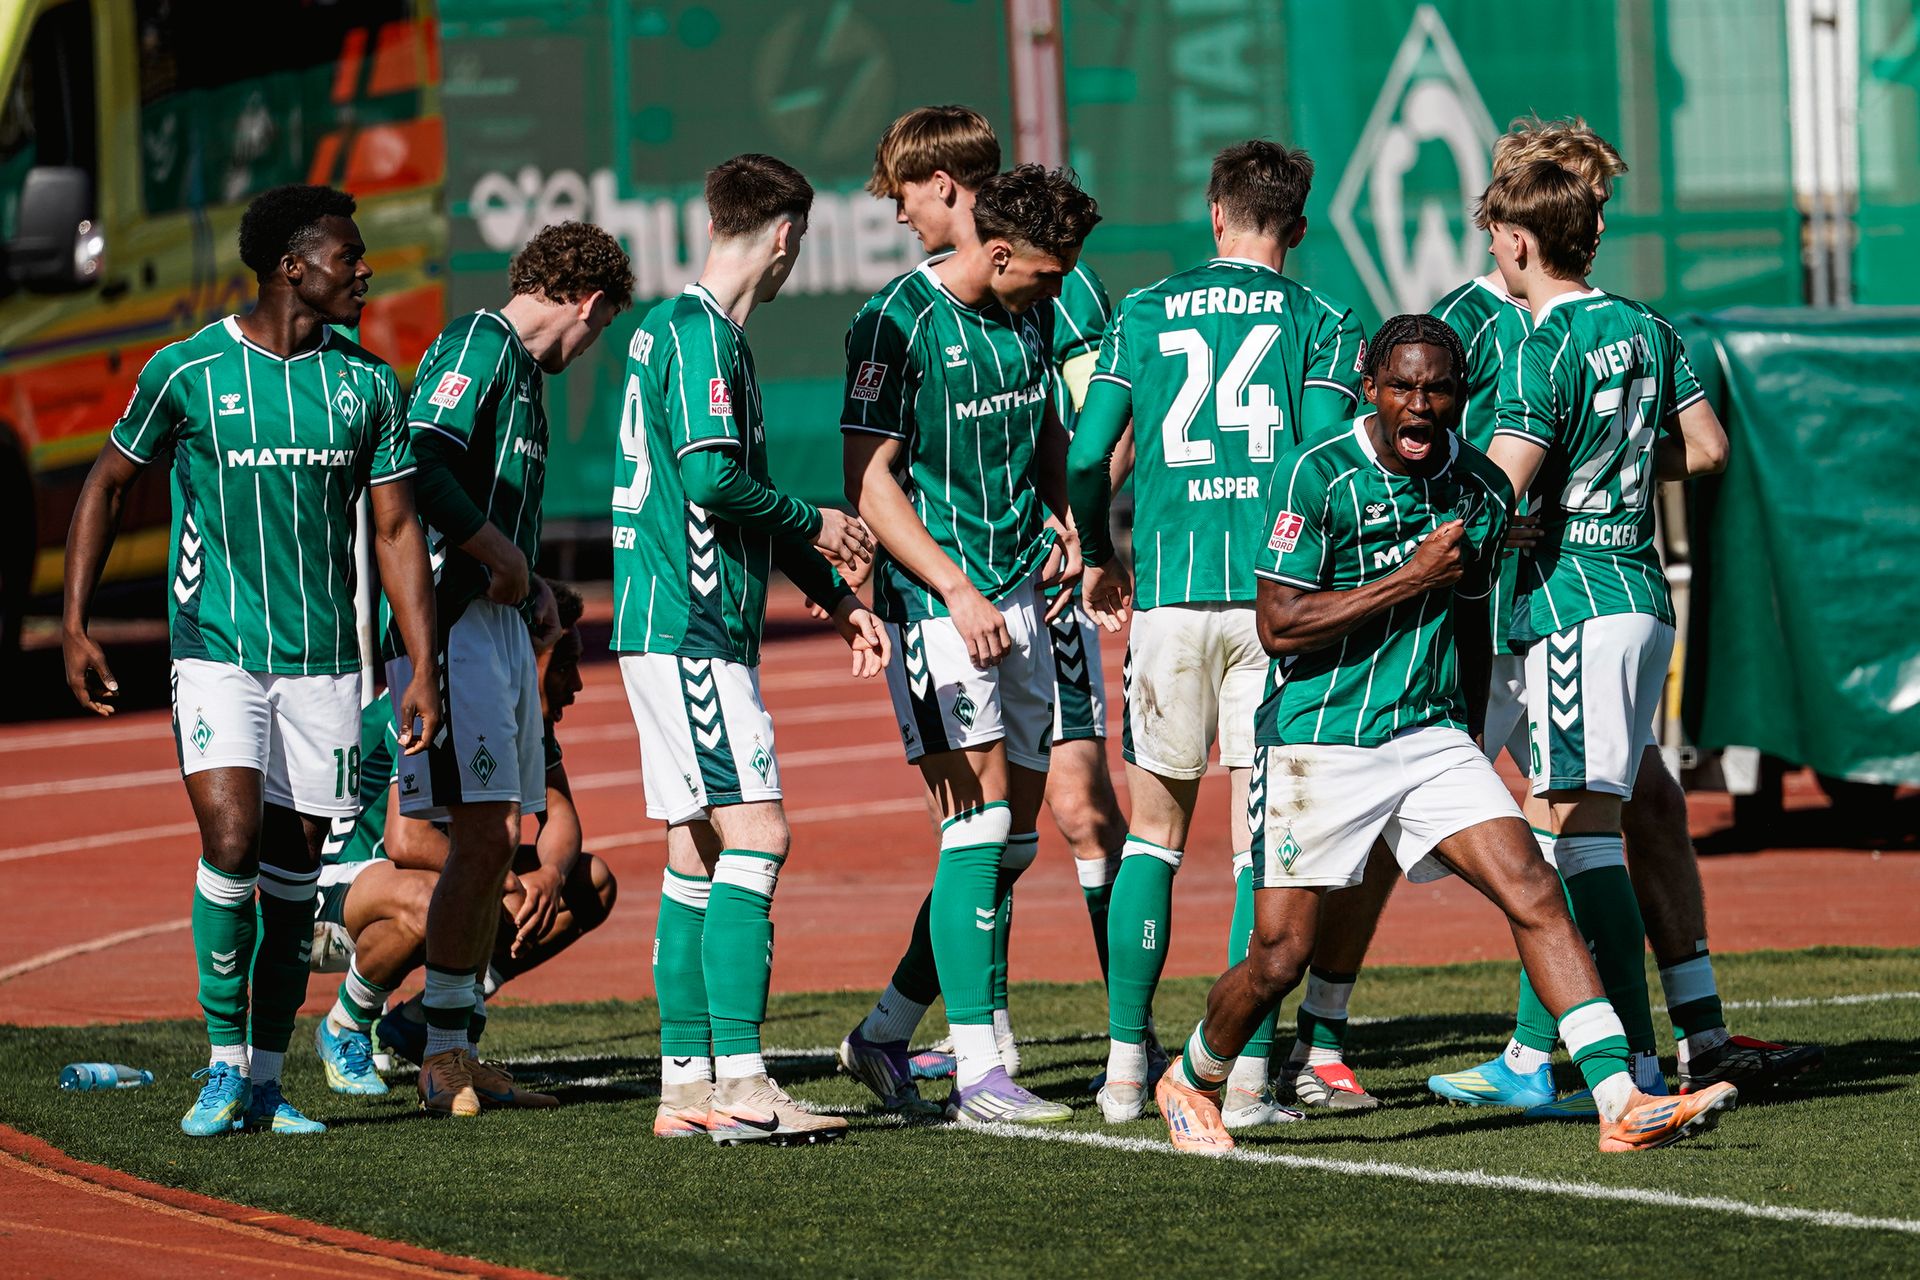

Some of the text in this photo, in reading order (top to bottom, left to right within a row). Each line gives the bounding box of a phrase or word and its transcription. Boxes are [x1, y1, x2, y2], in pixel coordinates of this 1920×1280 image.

[1164, 286, 1285, 320] WERDER
[432, 396, 456, 407] NORD
[853, 389, 878, 400] NORD
[955, 382, 1047, 420] MATTHÄI
[1158, 324, 1284, 468] 24
[1560, 376, 1657, 514] 26
[1188, 476, 1260, 502] KASPER
[1269, 540, 1294, 552] NORD
[1569, 518, 1639, 547] HÖCKER
[334, 745, 361, 800] 18
